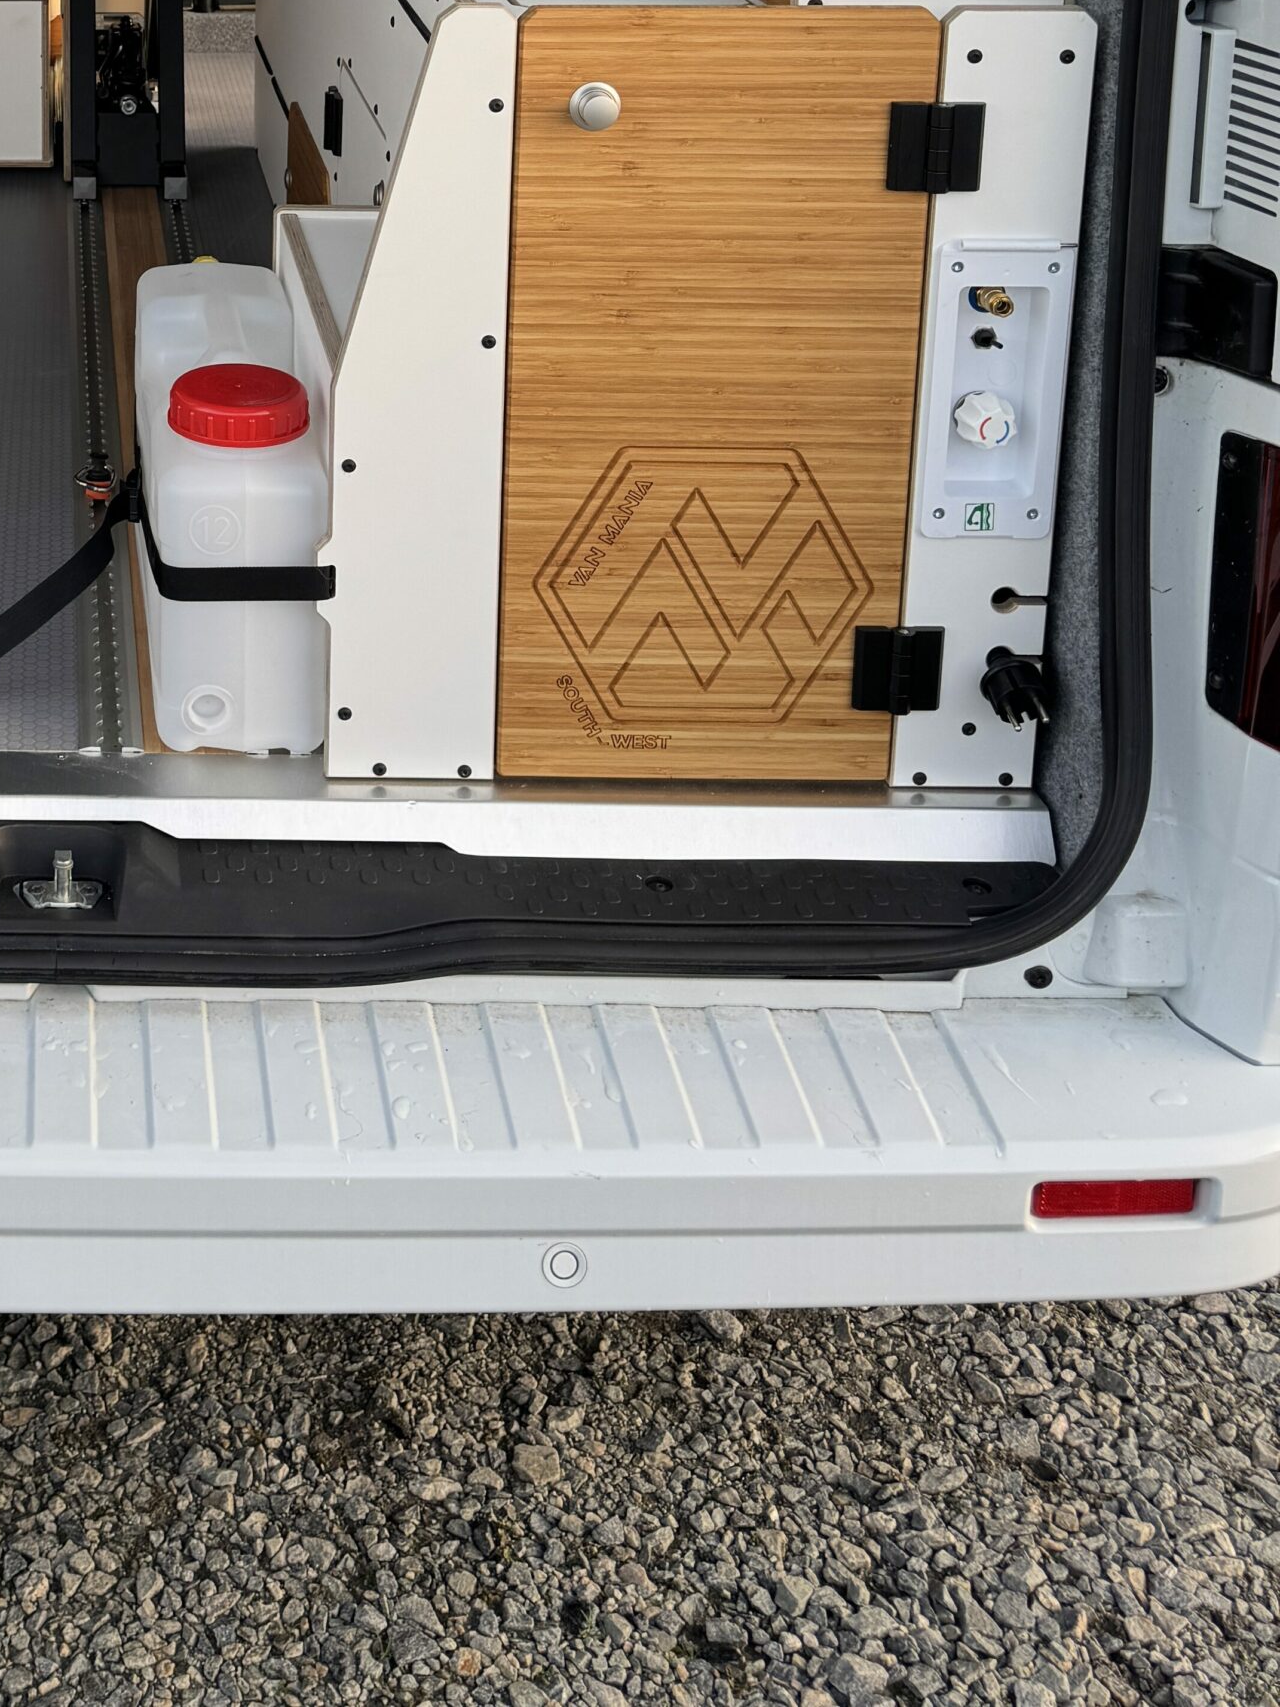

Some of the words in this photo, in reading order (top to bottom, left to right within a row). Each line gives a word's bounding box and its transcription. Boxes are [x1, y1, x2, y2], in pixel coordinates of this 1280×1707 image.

[196, 516, 231, 545] 12
[568, 546, 606, 586] VAN
[598, 480, 654, 546] MANIA
